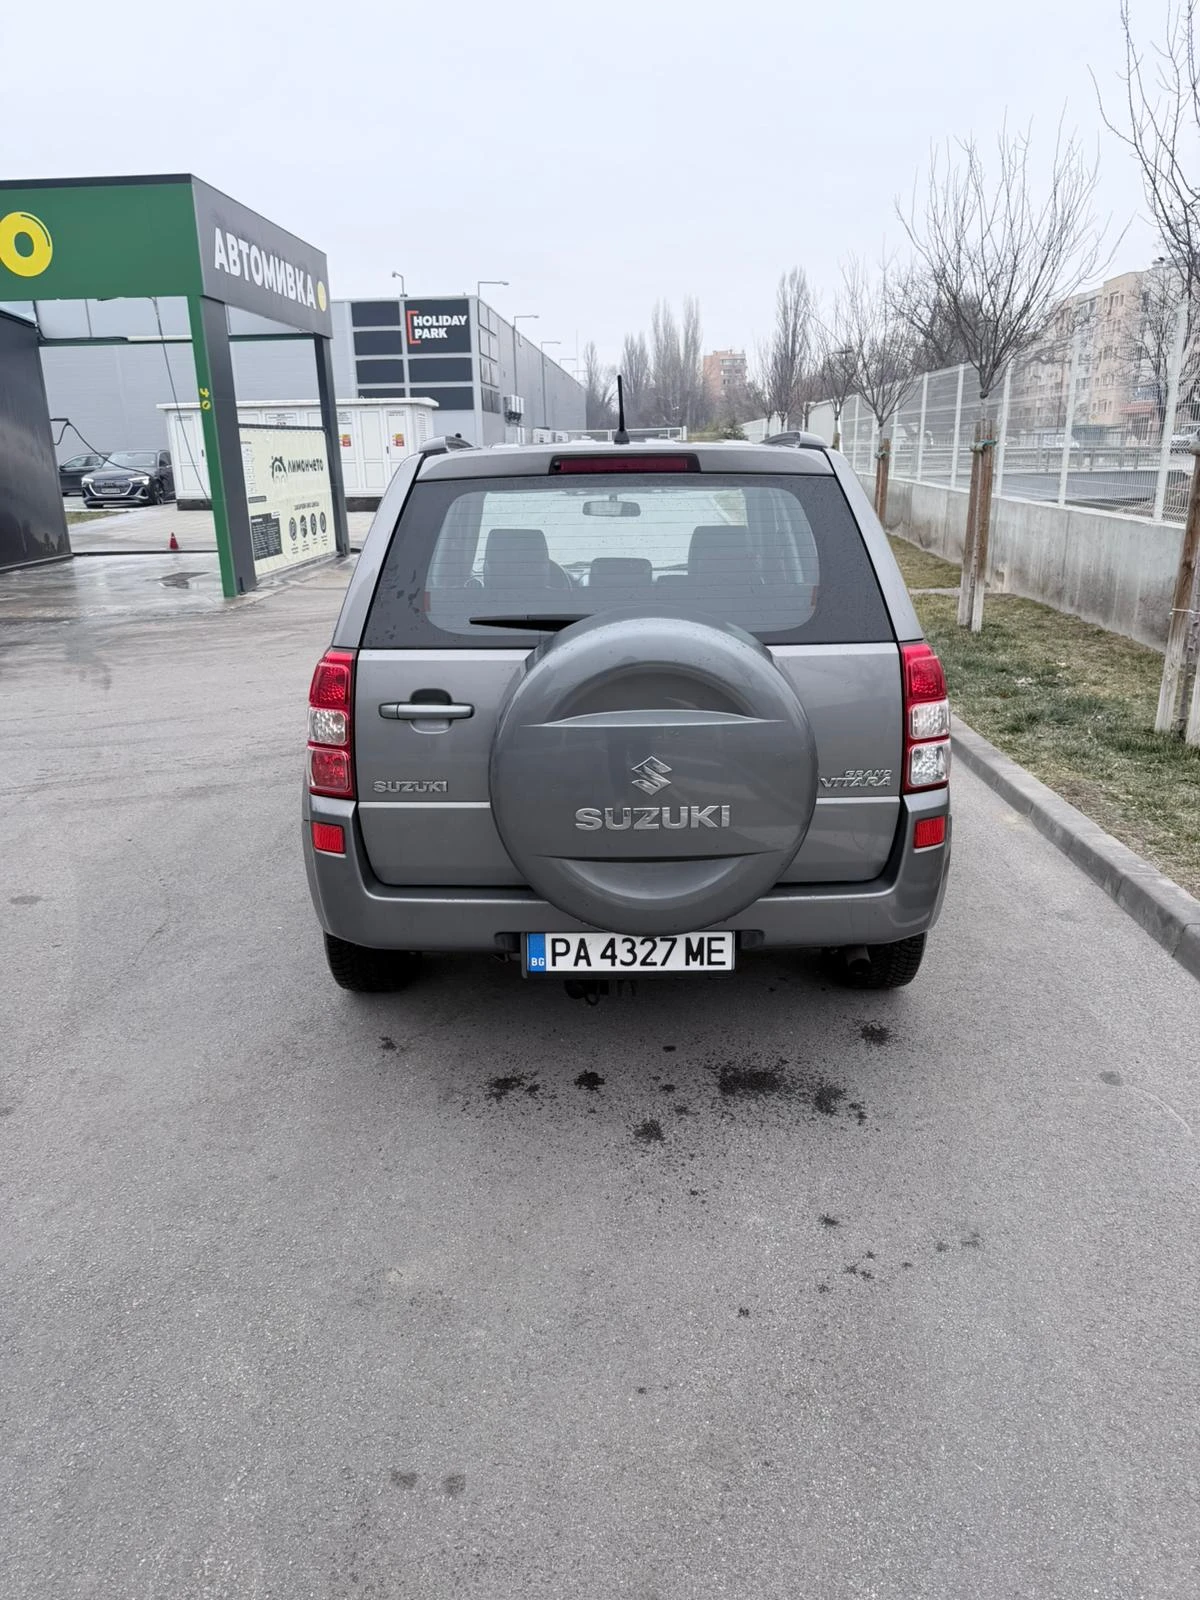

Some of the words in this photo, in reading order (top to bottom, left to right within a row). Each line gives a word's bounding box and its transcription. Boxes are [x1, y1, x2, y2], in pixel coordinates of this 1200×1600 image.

[214, 227, 317, 310] АВТОМИВКА
[413, 315, 467, 327] HOLIDAY
[414, 327, 448, 339] PARK
[287, 458, 324, 473] ЛИМОНЧЕТО
[844, 769, 892, 778] GRAND
[373, 780, 448, 793] SUZUKI
[820, 776, 892, 788] VITARA
[575, 805, 731, 831] SUZUKI
[551, 937, 592, 967] PA
[600, 937, 677, 967] 4327
[685, 936, 727, 966] ME
[531, 957, 545, 967] BG
